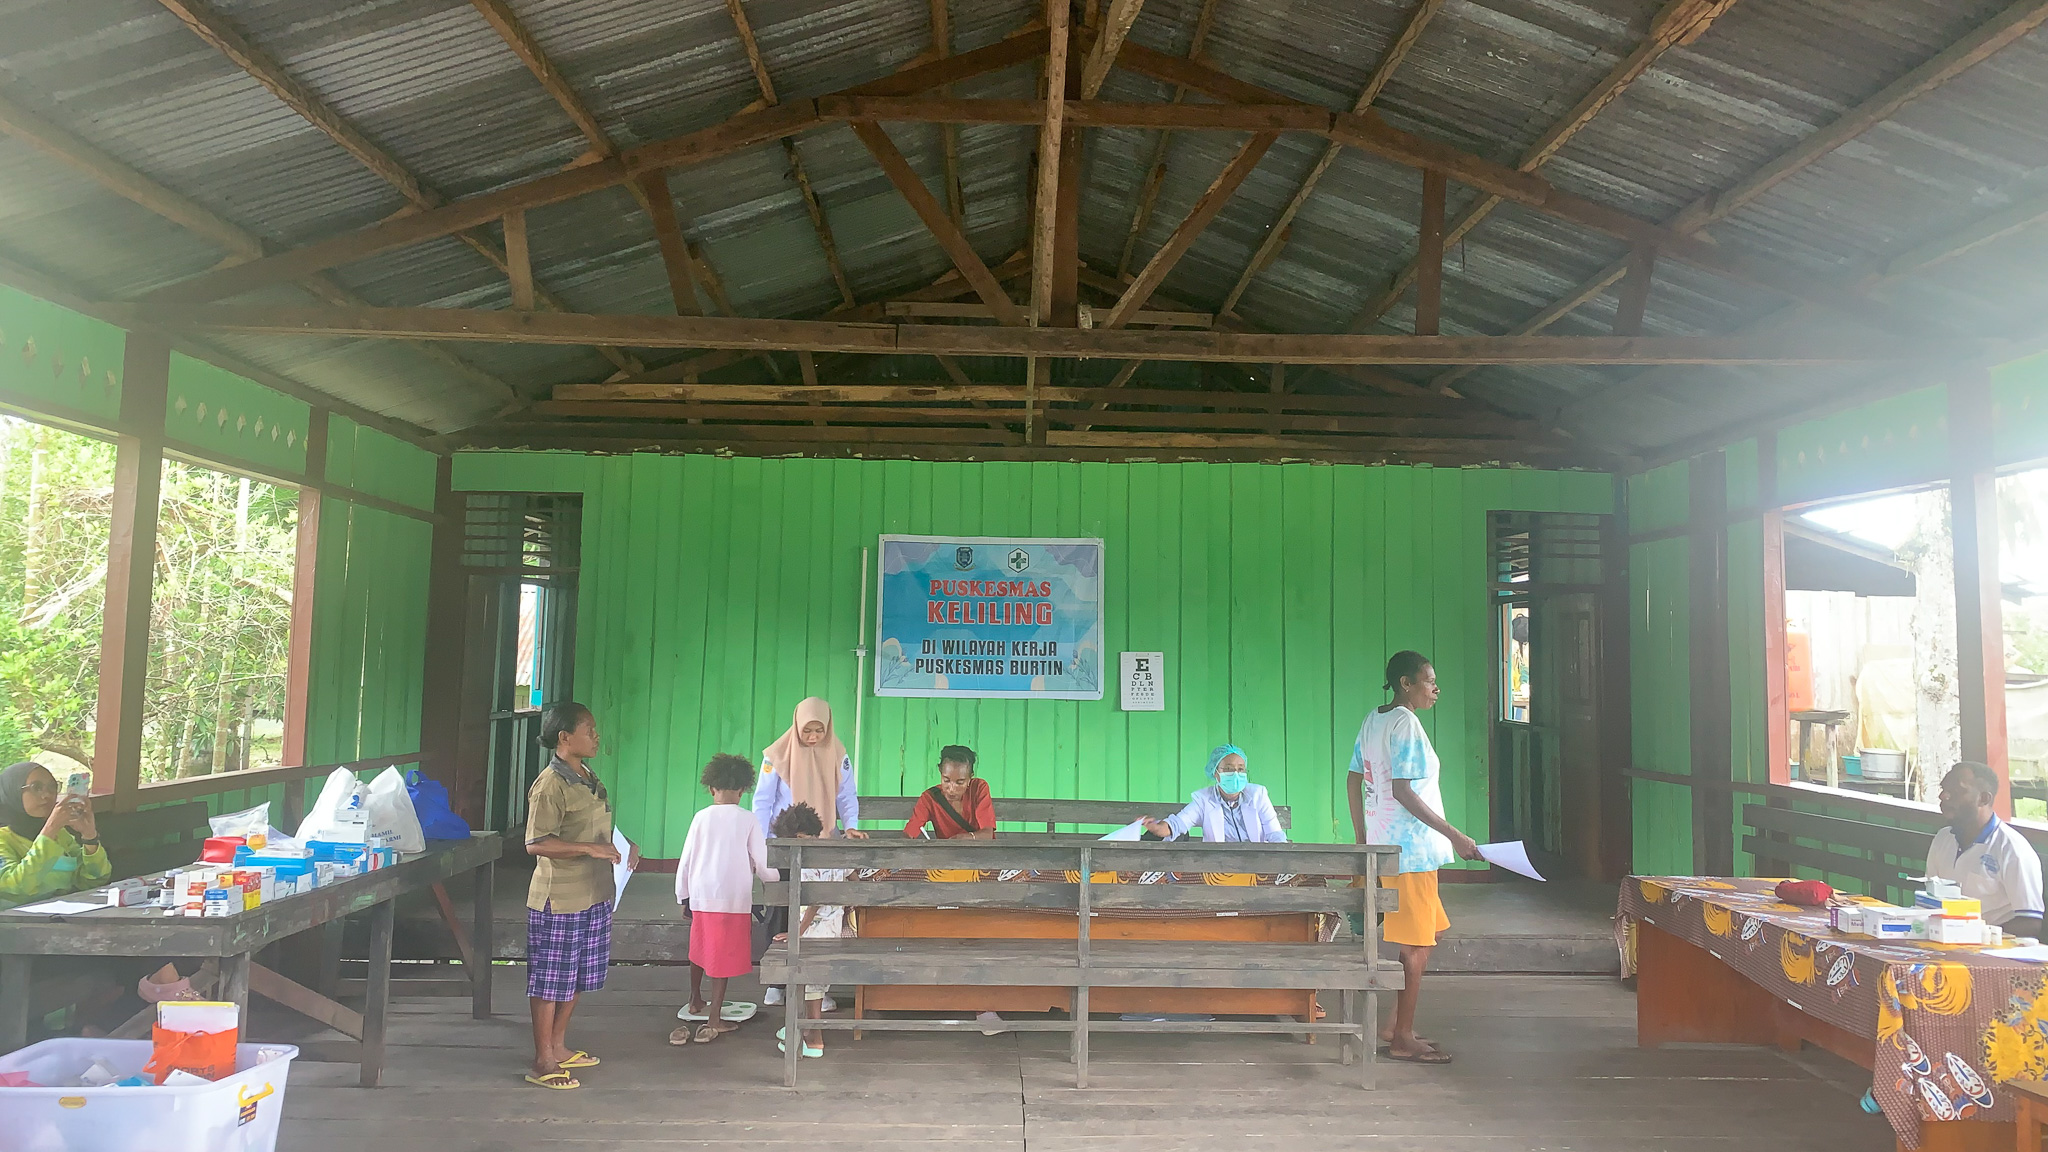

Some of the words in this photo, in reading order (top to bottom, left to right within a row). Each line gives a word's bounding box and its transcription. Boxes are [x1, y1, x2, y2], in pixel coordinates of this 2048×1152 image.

[929, 580, 1051, 598] PUSKESMAS
[927, 601, 1053, 625] KELILING
[922, 639, 936, 655] DI
[942, 640, 1006, 656] WILAYAH
[1011, 641, 1057, 657] KERJA
[915, 658, 1004, 675] PUSKESMAS
[1010, 660, 1063, 676] BURTIN
[1136, 659, 1149, 671] E
